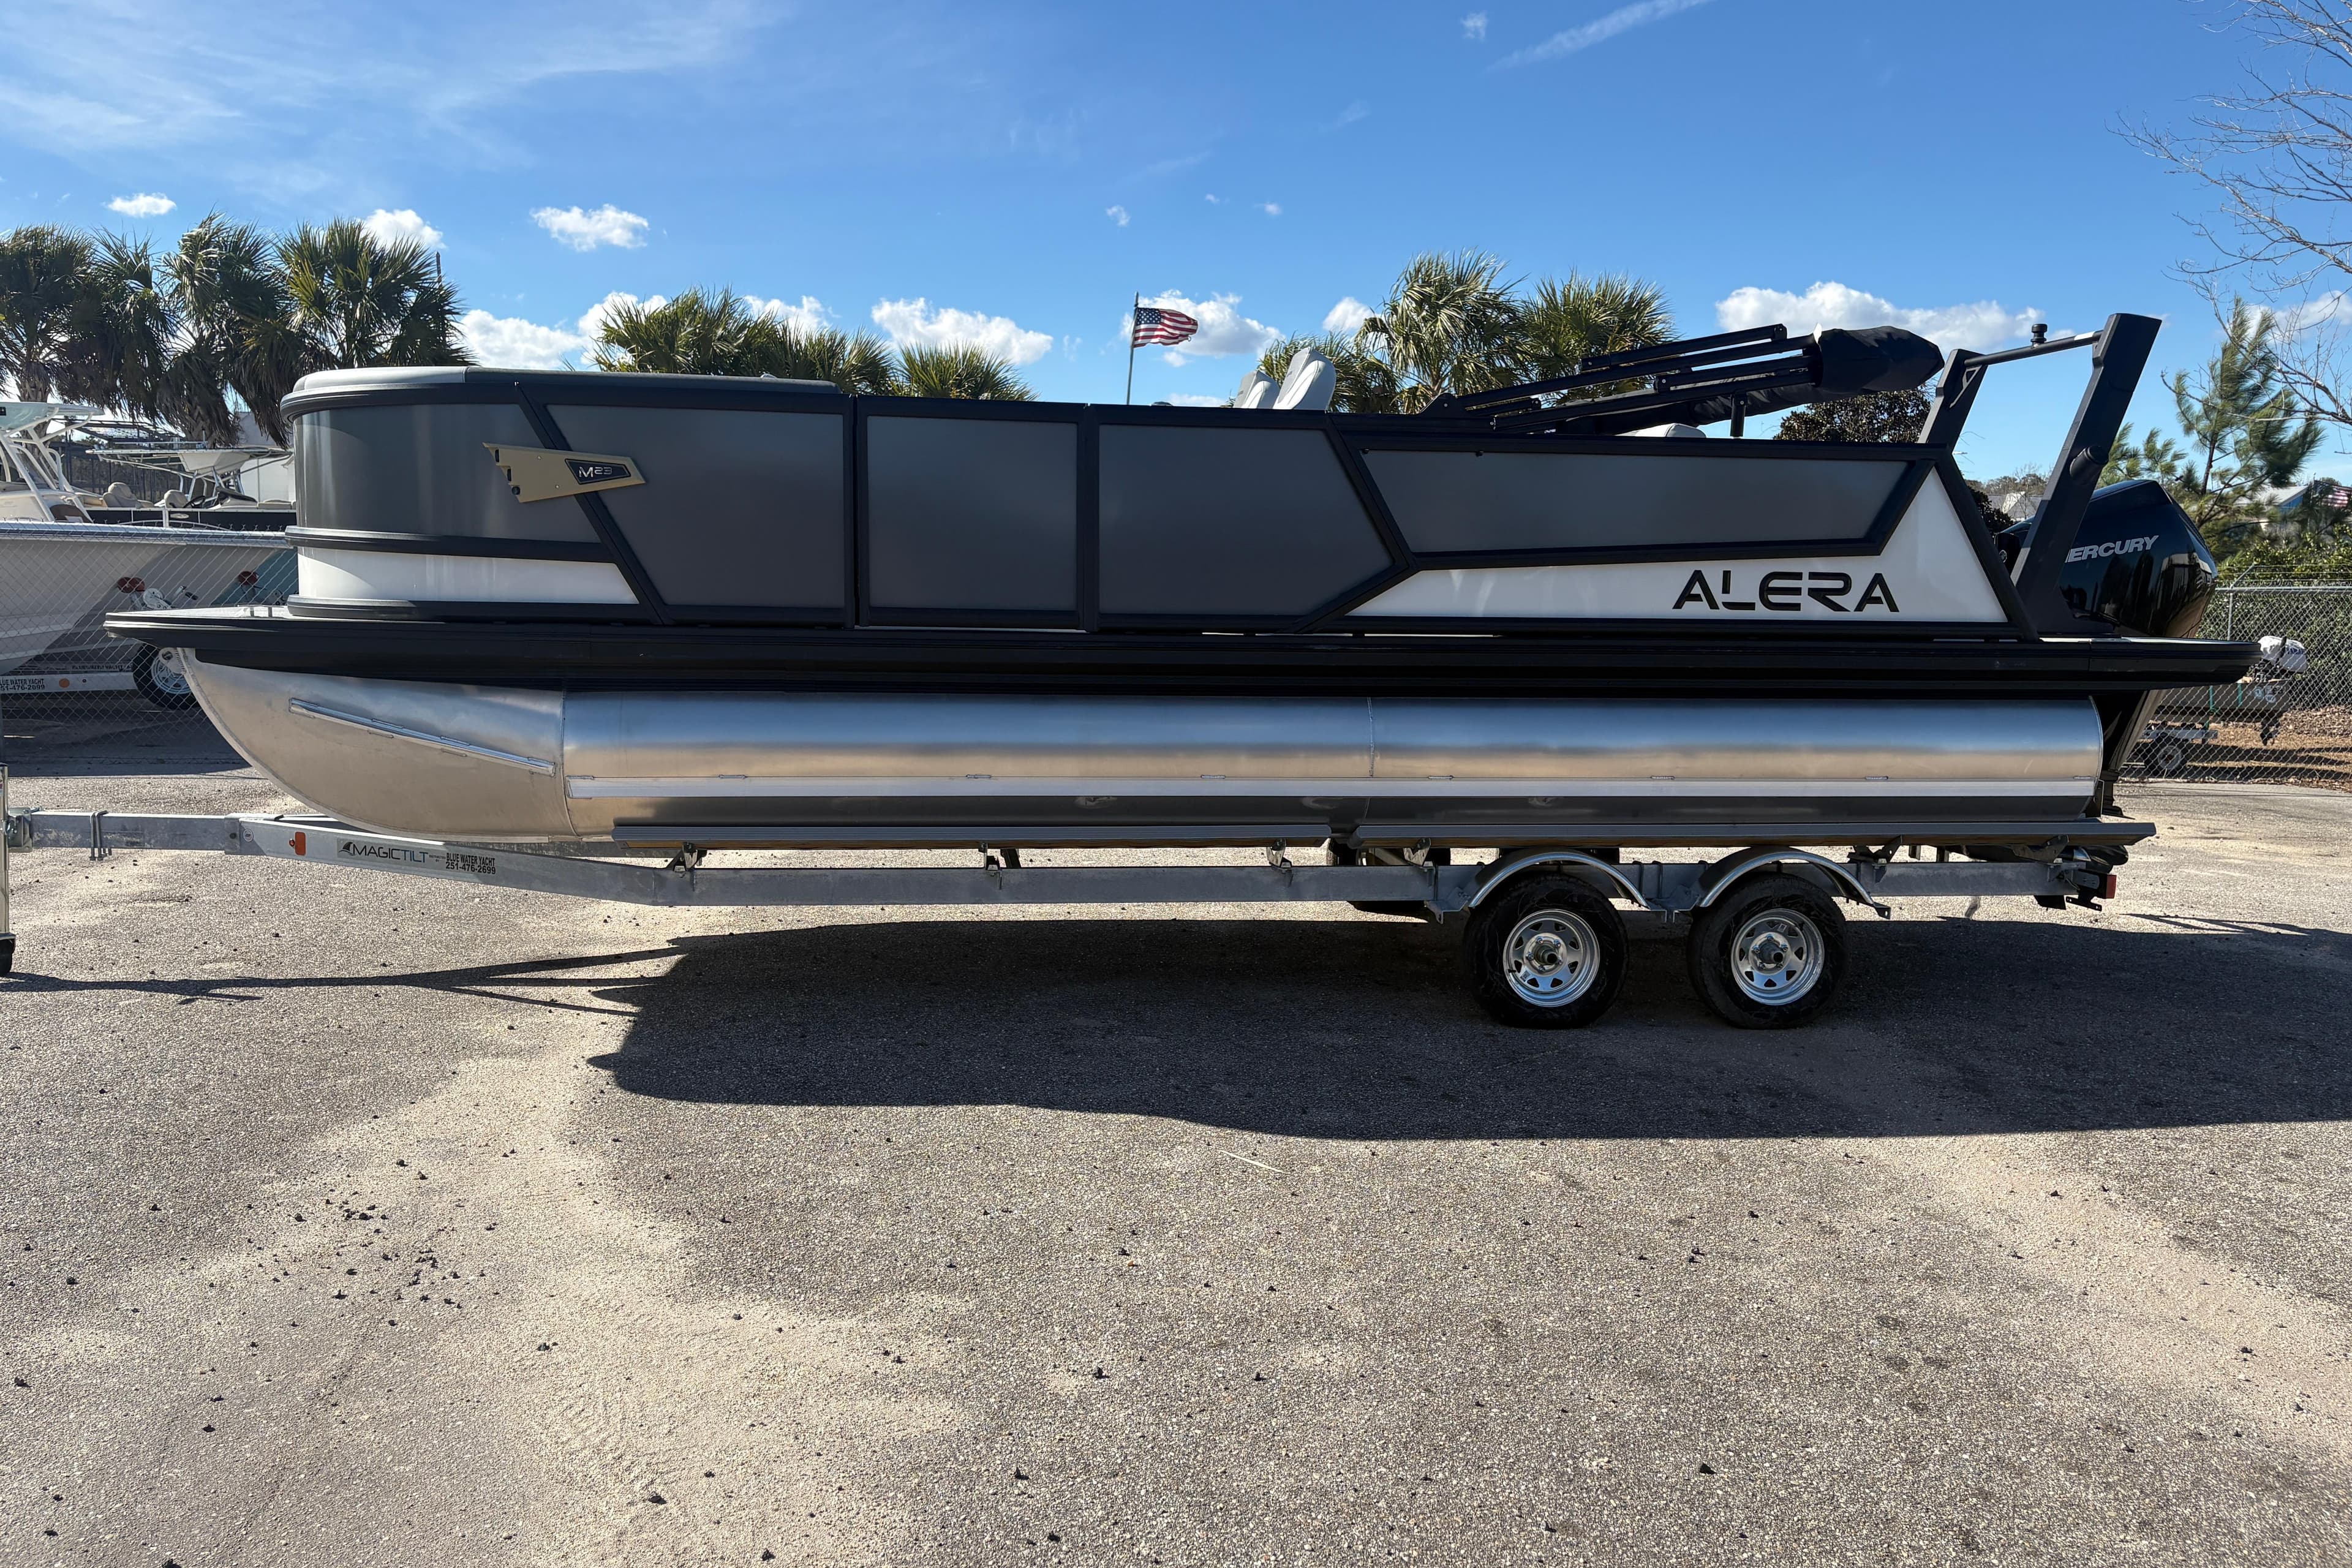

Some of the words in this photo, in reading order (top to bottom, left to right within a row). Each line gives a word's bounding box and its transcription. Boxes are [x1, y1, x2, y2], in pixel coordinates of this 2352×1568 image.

[579, 466, 612, 478] M23
[2064, 535, 2159, 564] ERCURY
[1672, 570, 1900, 612] ALERA
[353, 843, 429, 863] MAGICTILT
[446, 853, 459, 862] BLUE
[460, 854, 478, 865] WATER
[478, 856, 496, 867] YACHT
[445, 861, 496, 875] 251-476-2699
